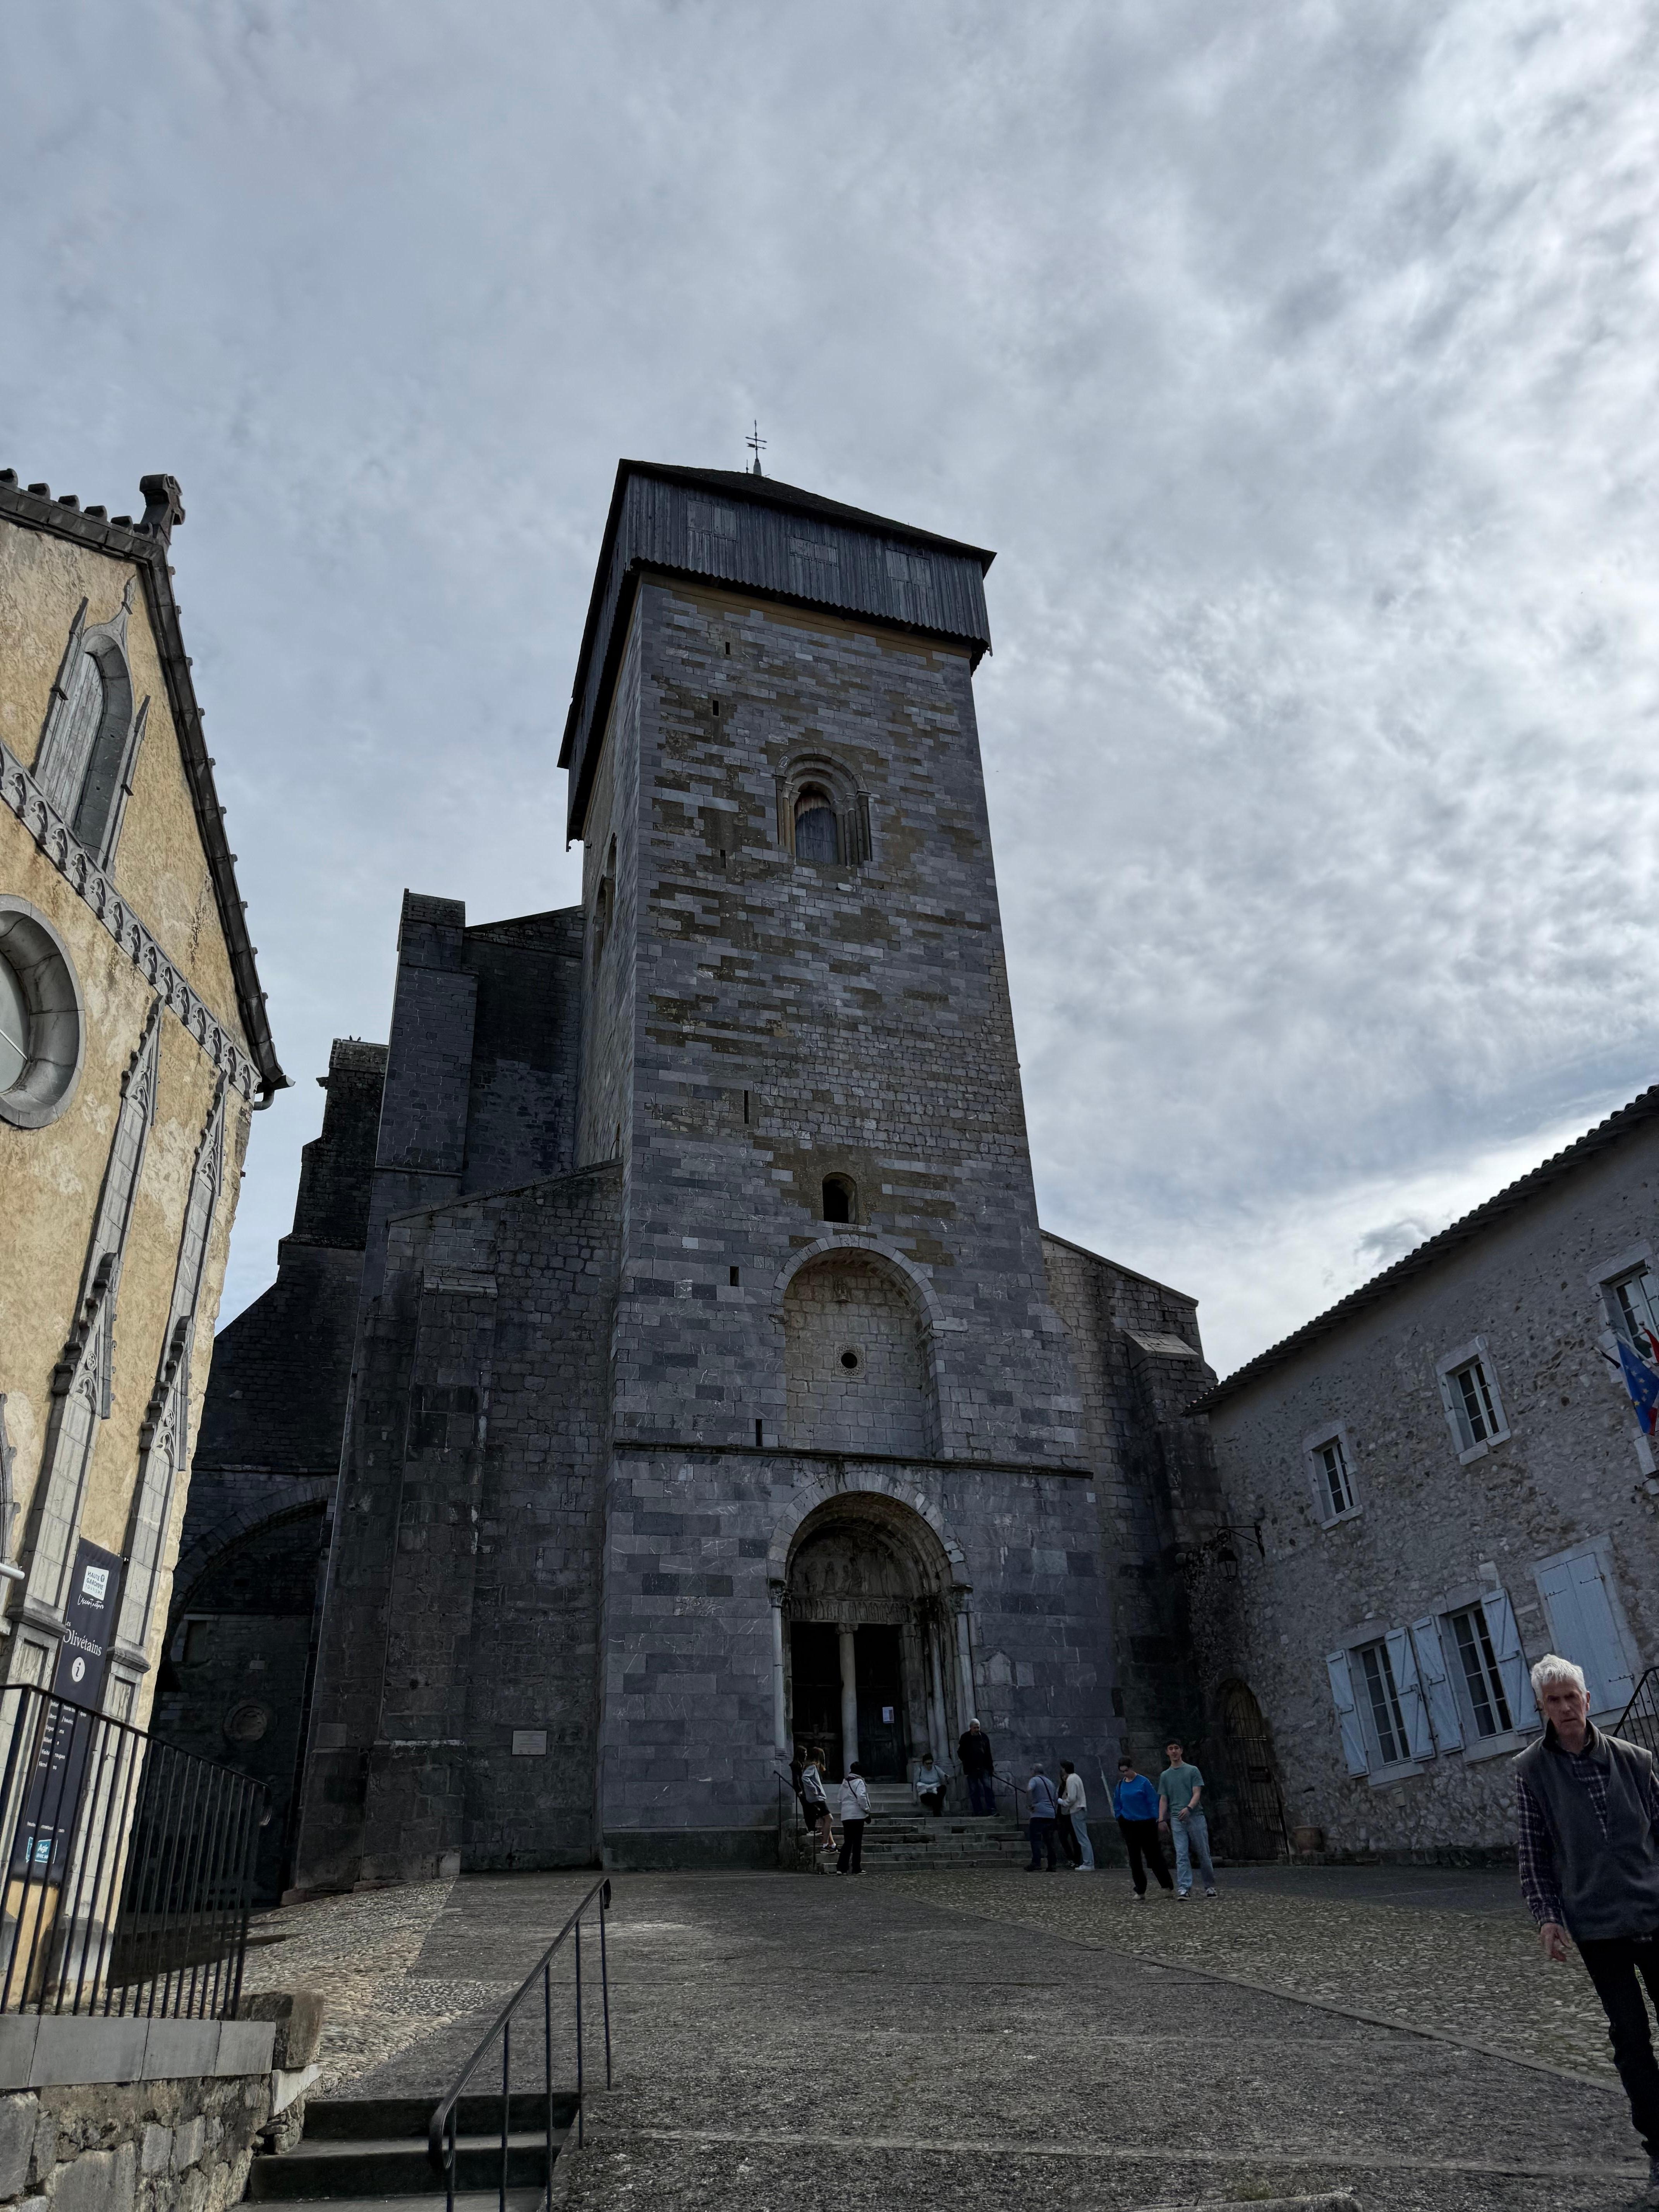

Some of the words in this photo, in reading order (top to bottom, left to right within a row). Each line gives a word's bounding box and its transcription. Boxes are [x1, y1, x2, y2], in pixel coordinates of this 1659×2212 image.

[88, 1571, 100, 1581] HAUTE
[86, 1578, 104, 1590] GARONNE
[63, 1629, 102, 1656] Olivétains
